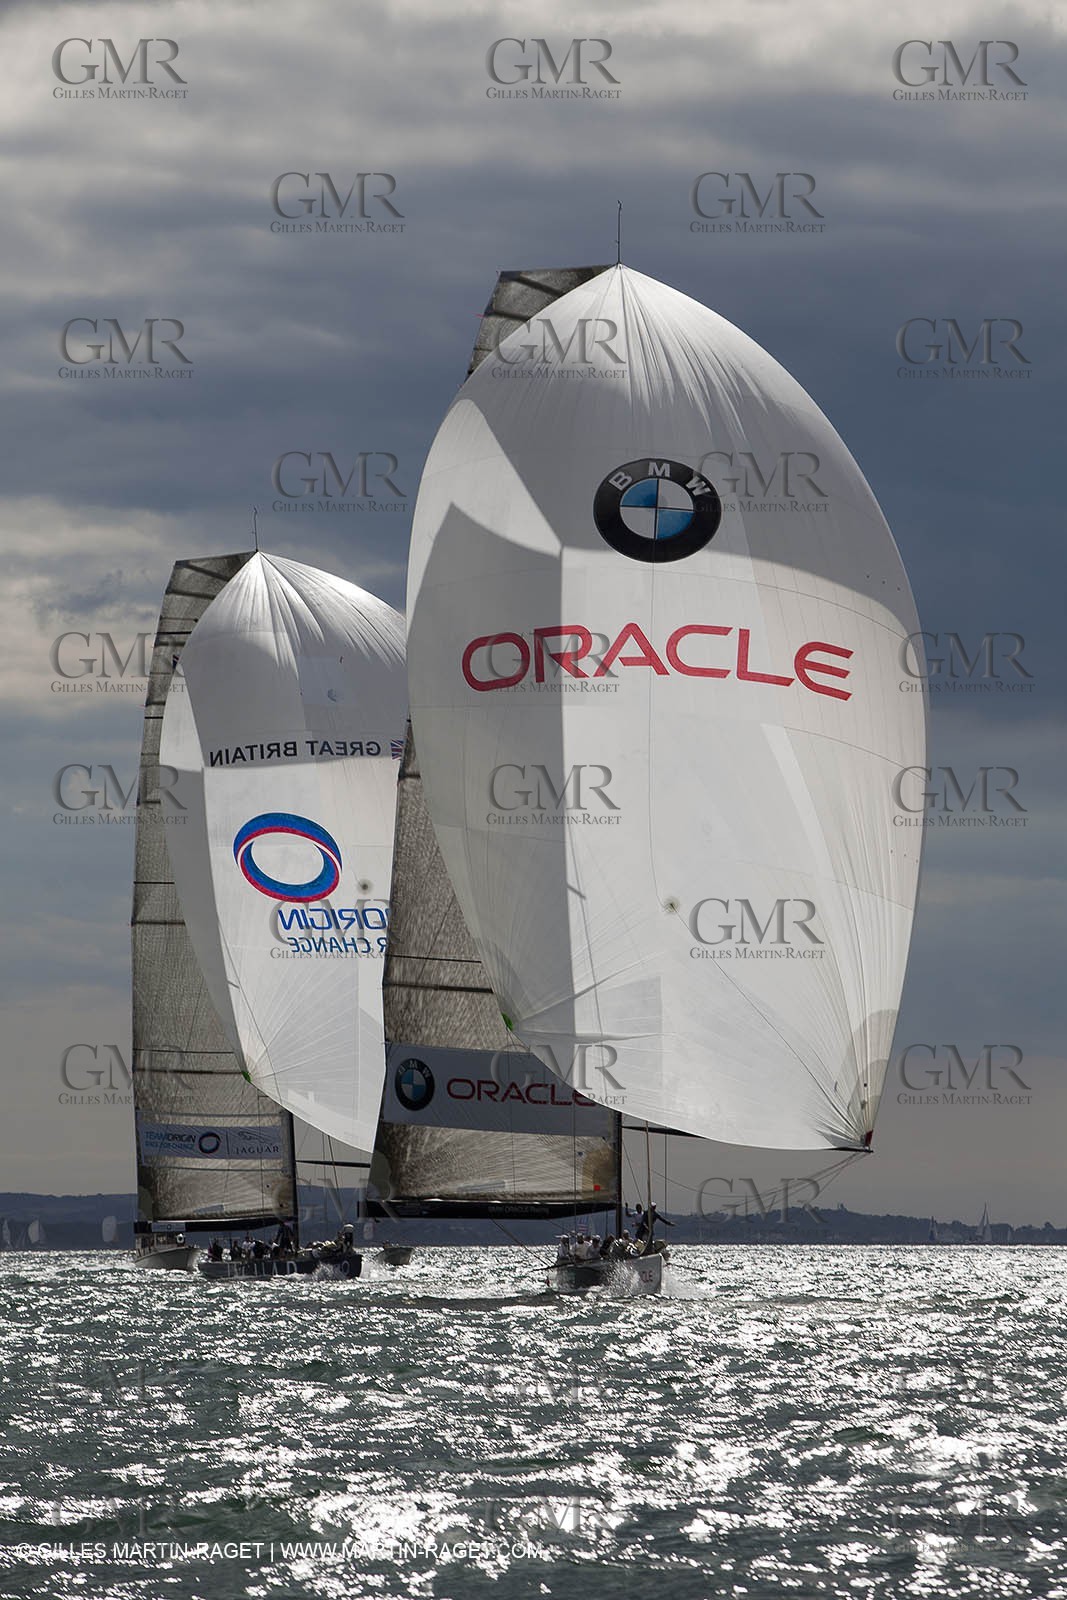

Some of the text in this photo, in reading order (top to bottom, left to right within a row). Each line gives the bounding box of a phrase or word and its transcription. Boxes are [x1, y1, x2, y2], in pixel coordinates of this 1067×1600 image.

[608, 461, 711, 497] BMW
[462, 622, 854, 701] ORACLE
[236, 1145, 279, 1155] JAGUAR
